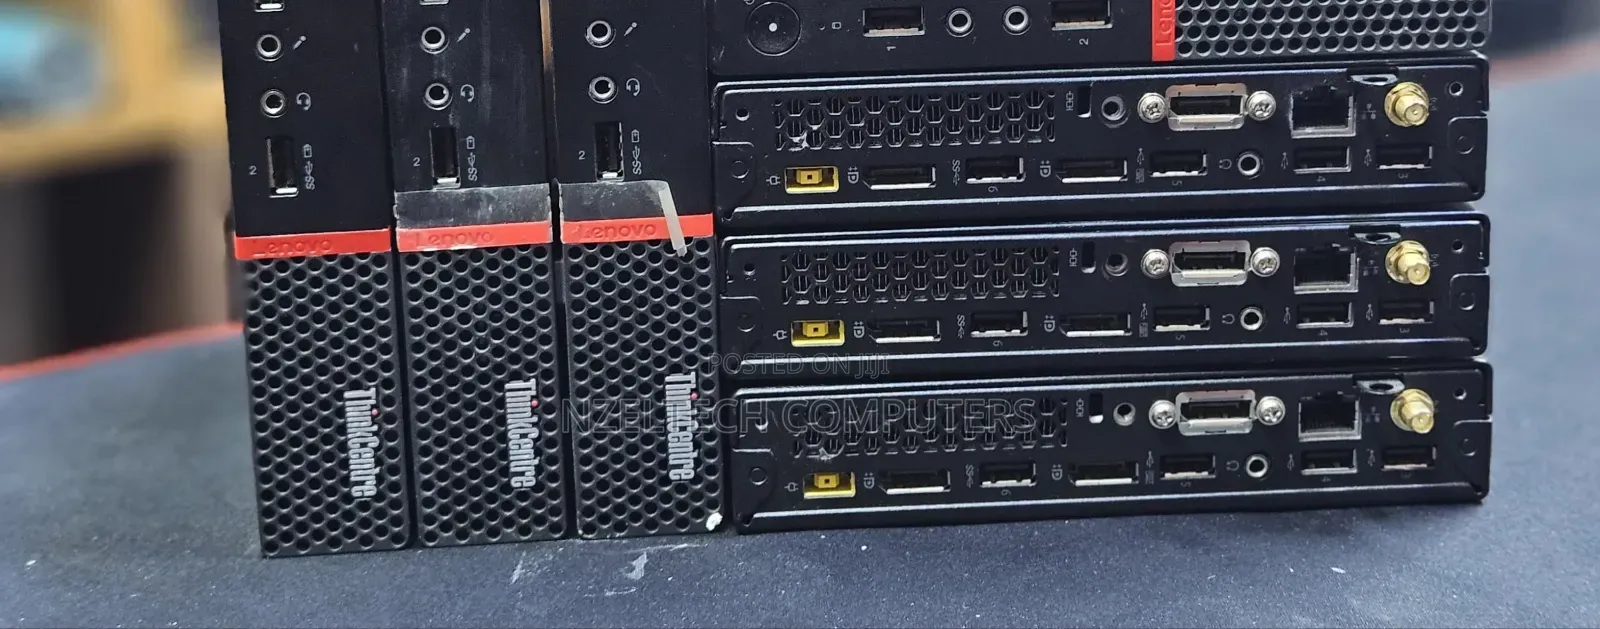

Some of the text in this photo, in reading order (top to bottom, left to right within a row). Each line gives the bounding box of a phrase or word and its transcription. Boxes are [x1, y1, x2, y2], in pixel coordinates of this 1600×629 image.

[1078, 37, 1089, 46] 2
[412, 156, 421, 167] 2
[577, 150, 586, 160] 2
[249, 165, 258, 175] 2
[252, 240, 332, 257] Lenovo
[415, 231, 494, 249] Lenovo
[504, 378, 540, 488] ThinkCentre
[664, 371, 700, 481] ThinkCentre
[343, 387, 380, 497] ThinkCentre
